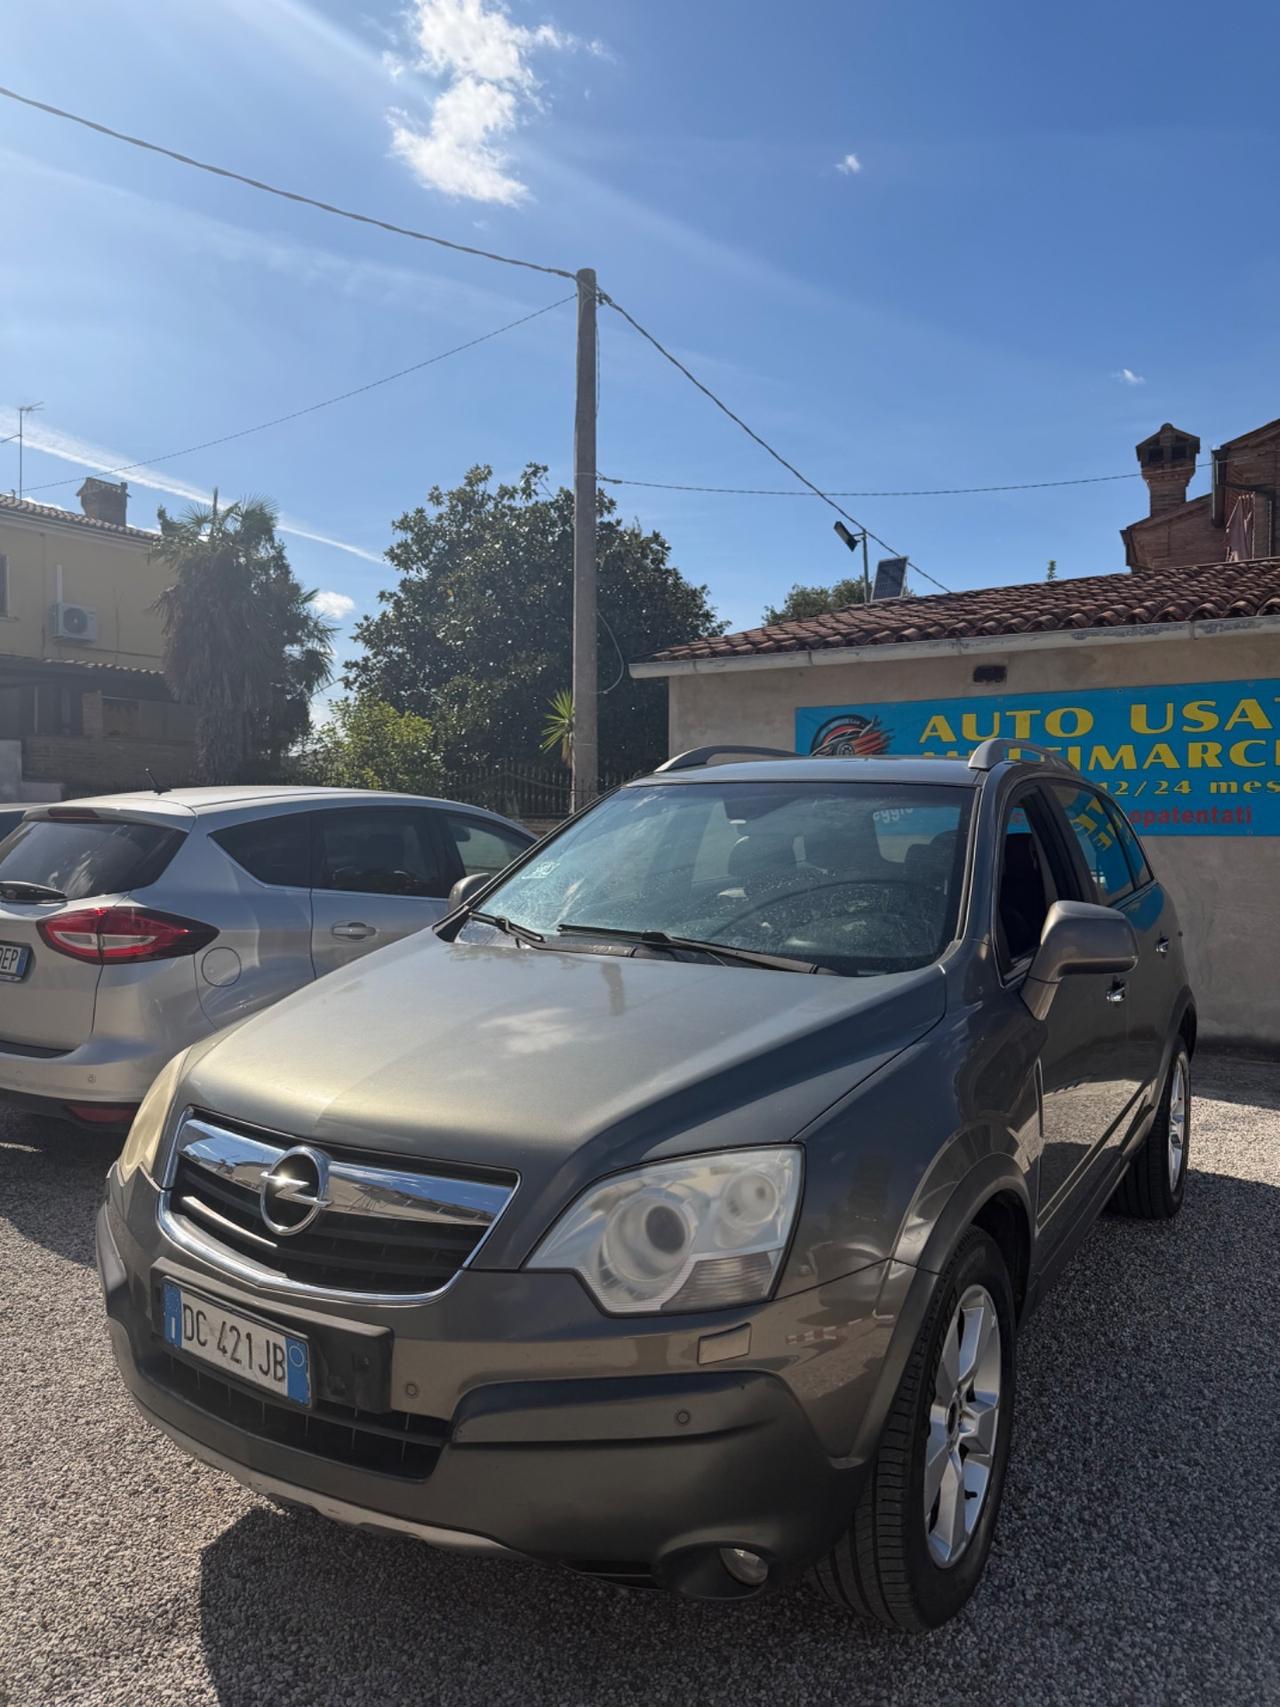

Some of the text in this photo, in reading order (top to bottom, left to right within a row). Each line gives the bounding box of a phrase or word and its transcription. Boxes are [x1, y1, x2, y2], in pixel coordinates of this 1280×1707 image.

[918, 698, 1280, 744] AUTO USA
[183, 1304, 286, 1382] DC 421 JB
